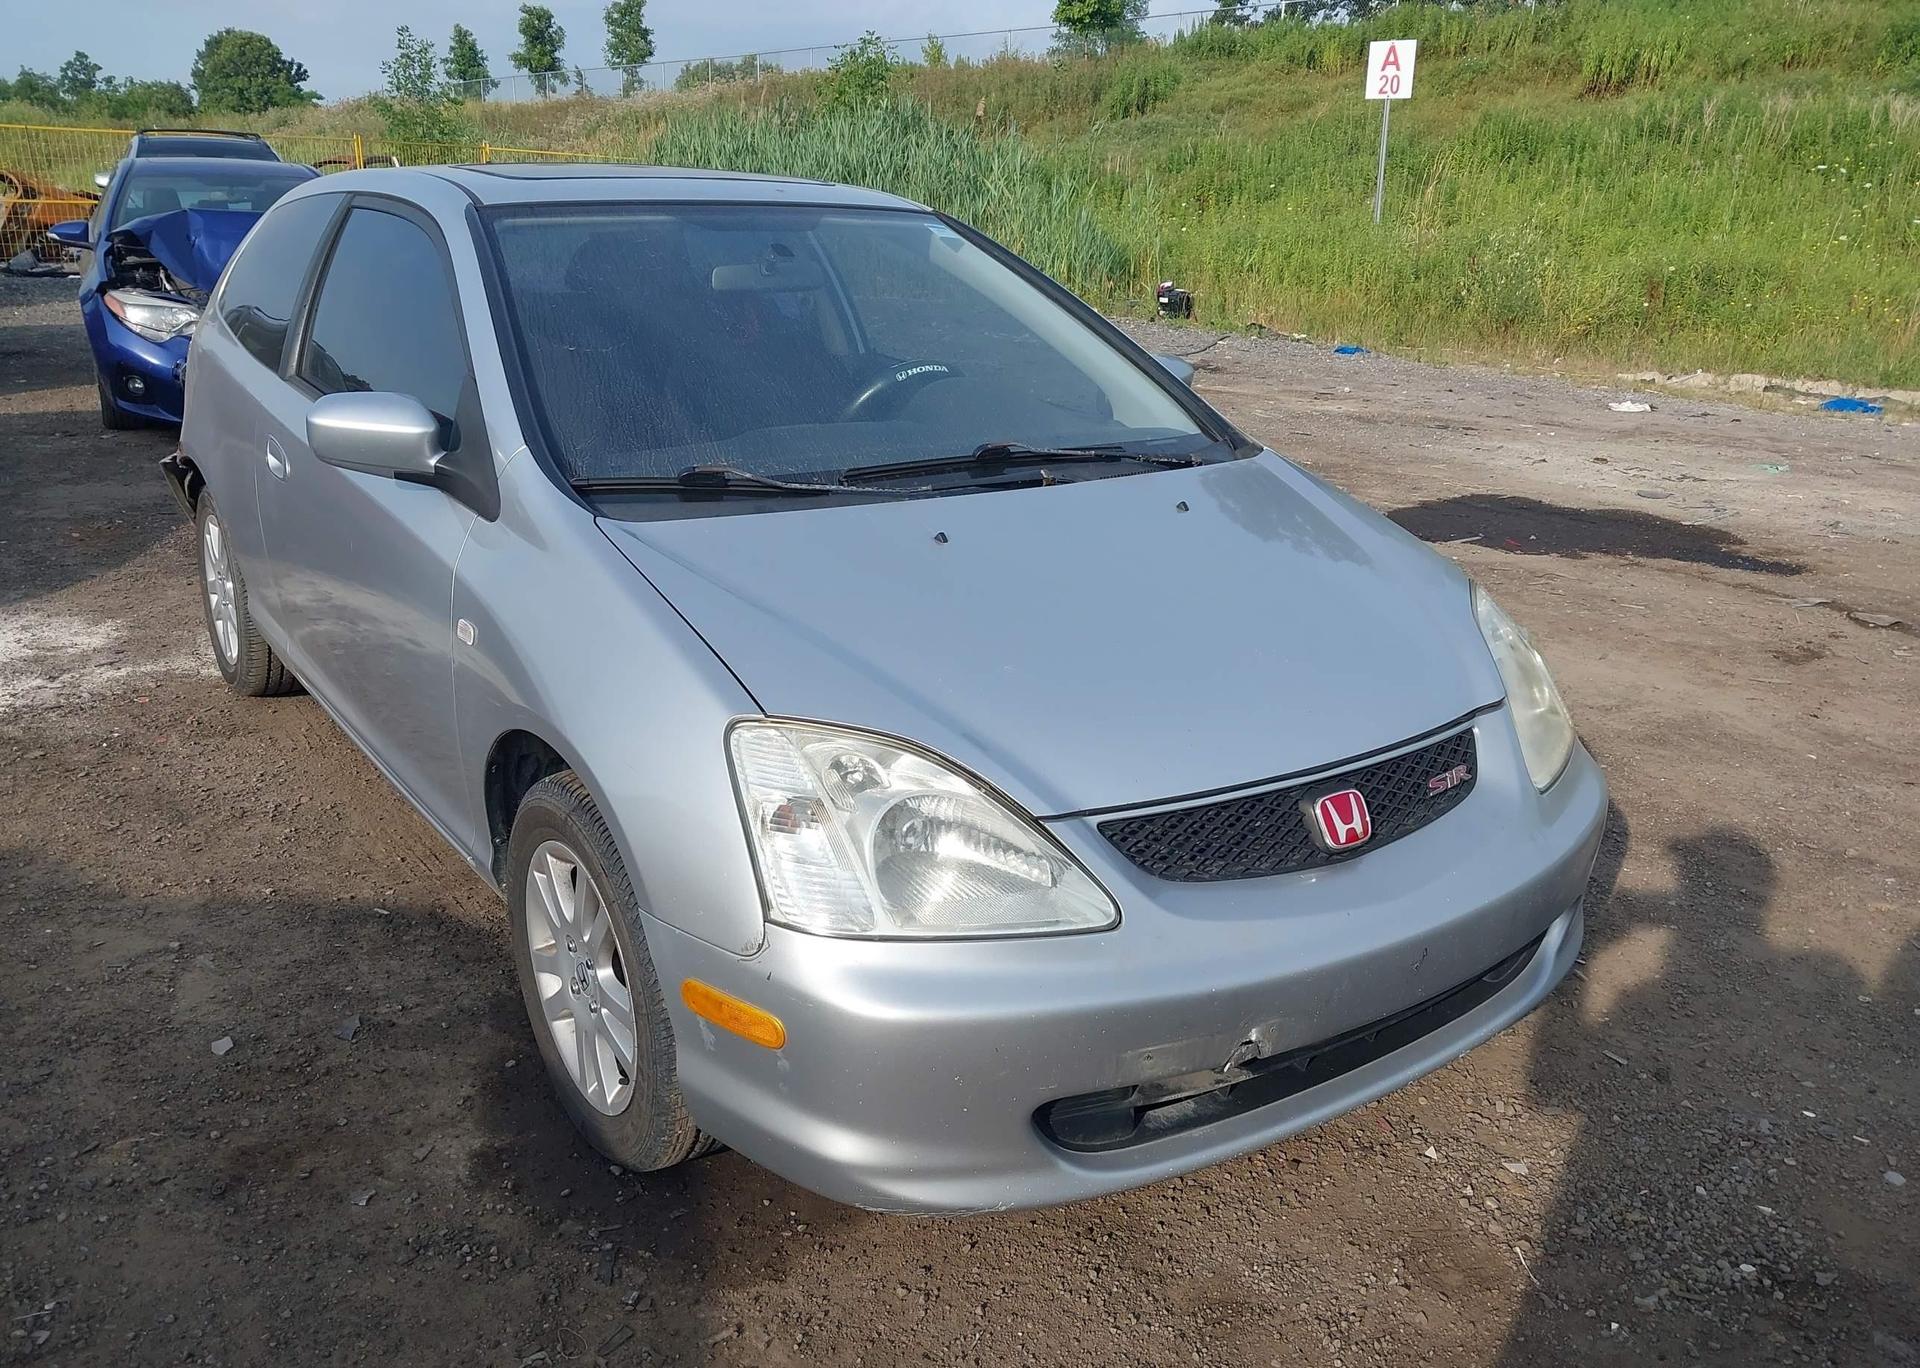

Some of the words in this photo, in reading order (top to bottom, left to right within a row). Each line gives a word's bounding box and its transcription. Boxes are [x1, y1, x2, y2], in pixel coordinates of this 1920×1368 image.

[1381, 45, 1400, 72] A
[1379, 74, 1400, 95] 20
[907, 364, 949, 376] HONDA
